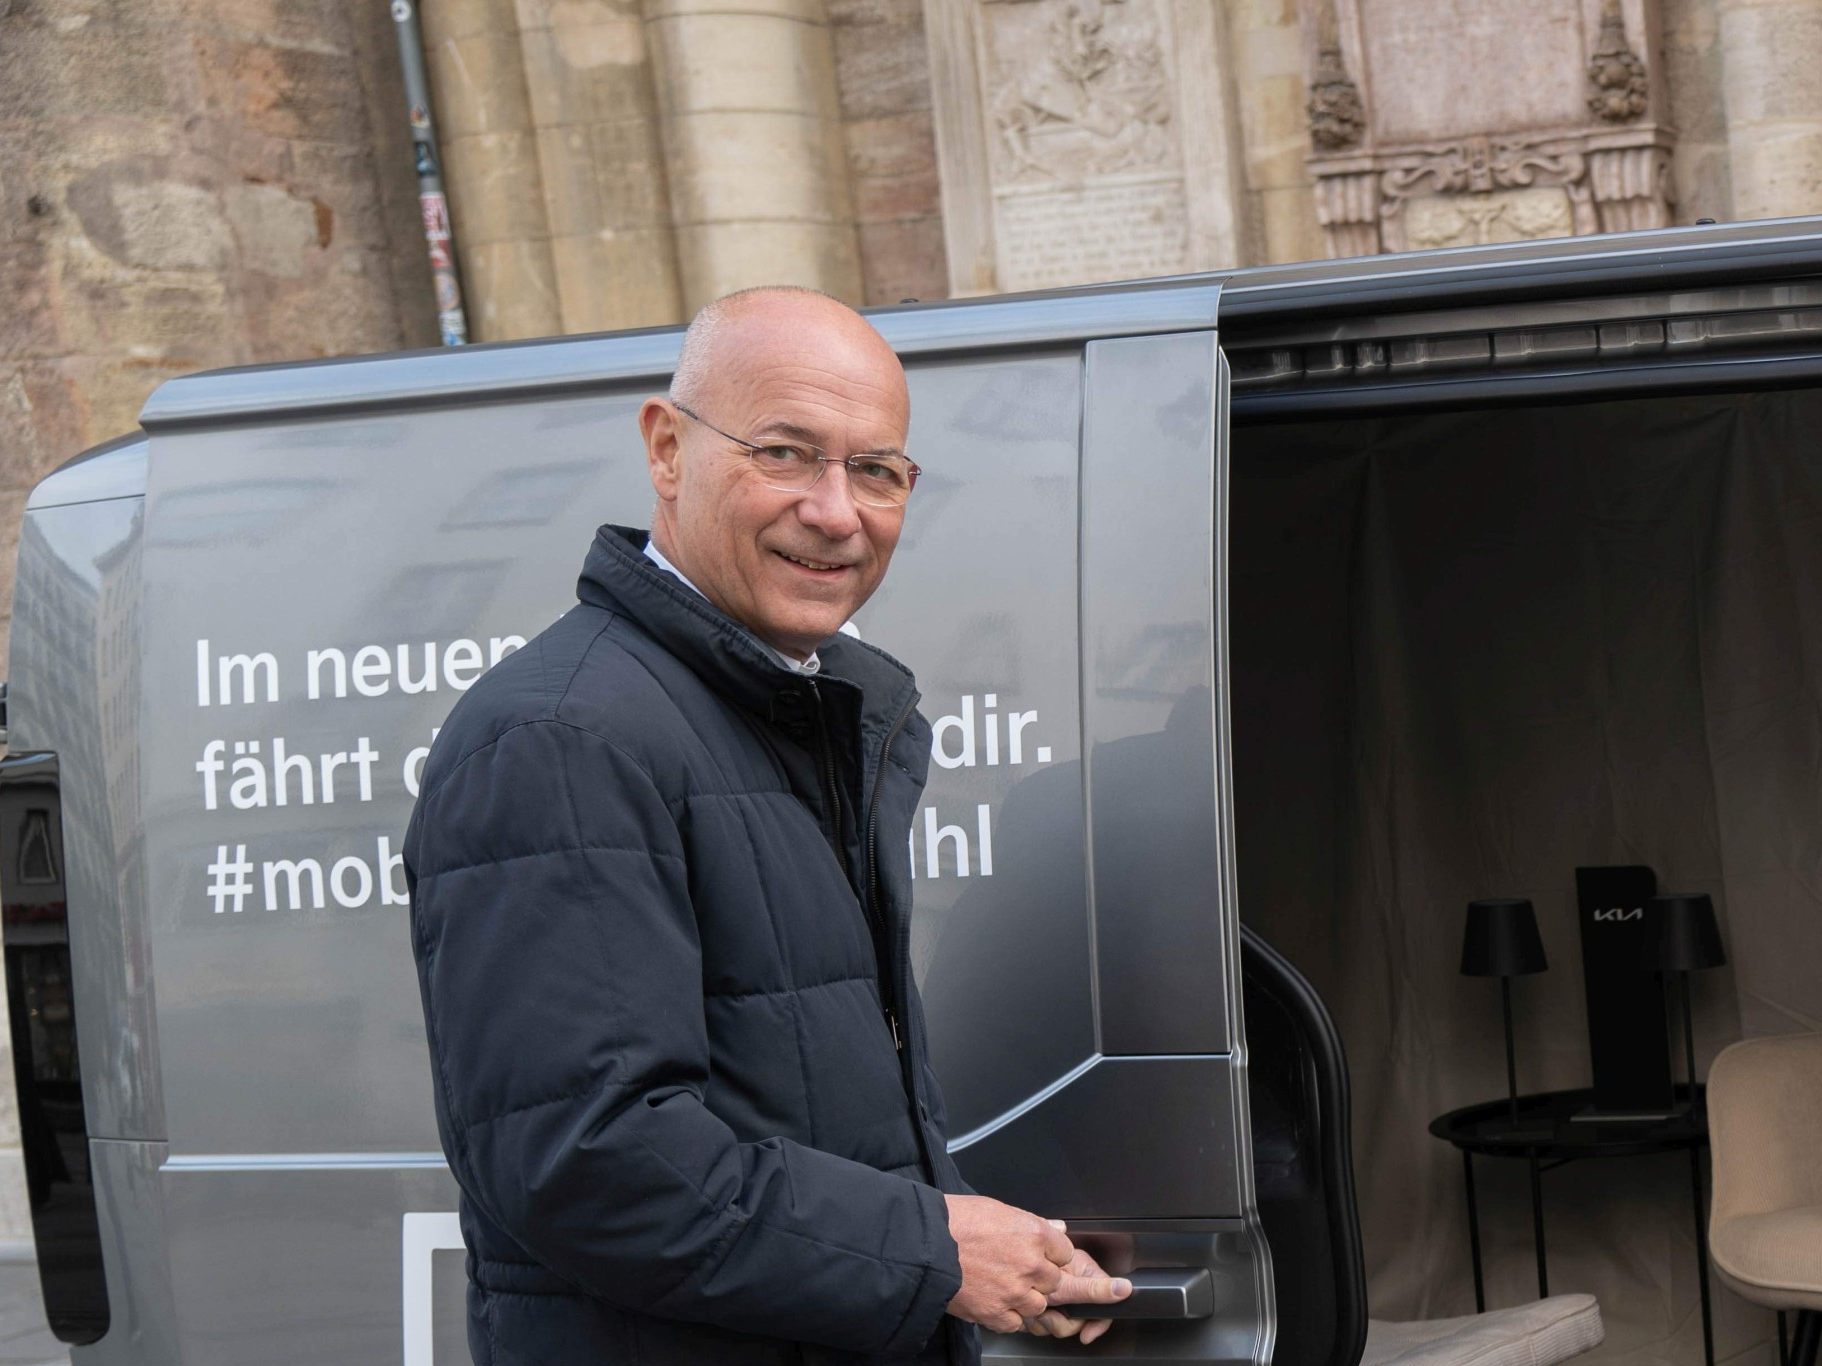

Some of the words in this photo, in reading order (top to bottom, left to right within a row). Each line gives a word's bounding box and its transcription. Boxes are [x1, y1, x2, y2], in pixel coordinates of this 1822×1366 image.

[197, 639, 279, 707] Im
[931, 693, 1052, 769] dir.
[195, 737, 379, 810] fährt
[1594, 907, 1643, 921] KIA
